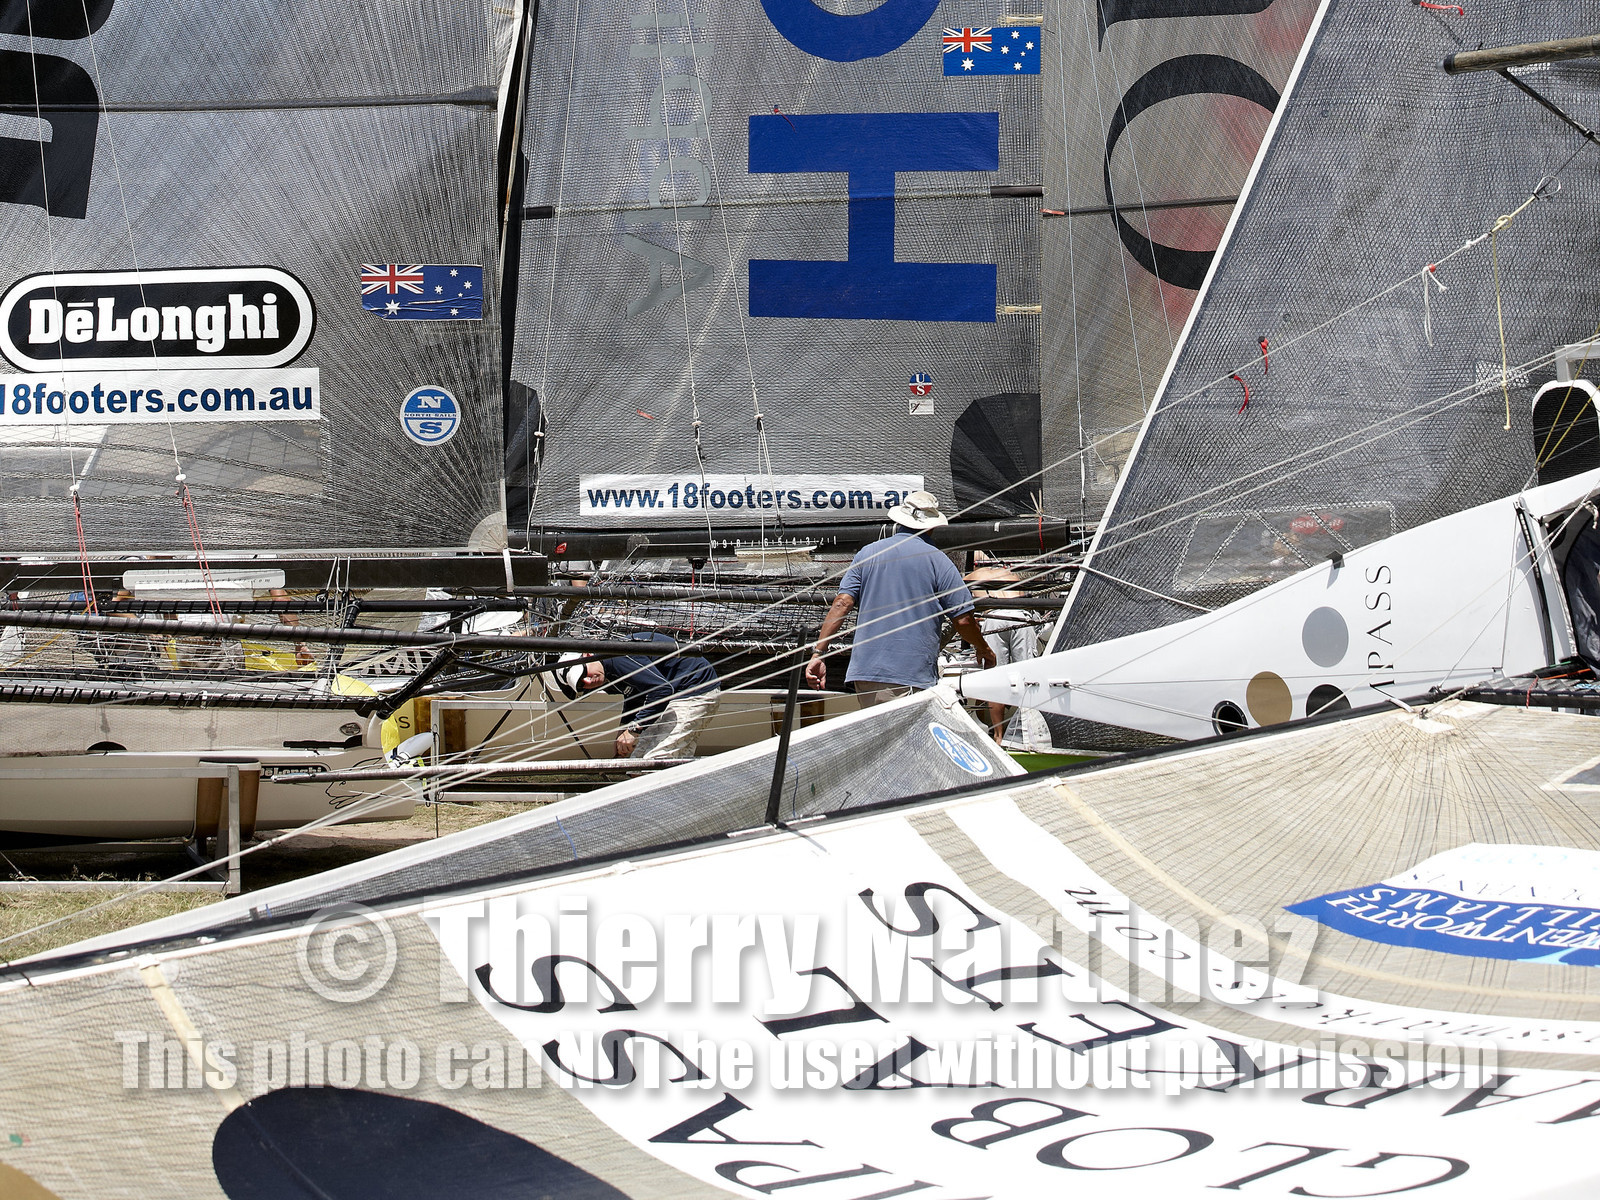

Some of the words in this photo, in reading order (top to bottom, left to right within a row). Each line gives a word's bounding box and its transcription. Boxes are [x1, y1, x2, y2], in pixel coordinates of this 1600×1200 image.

[587, 482, 918, 510] www.18footers.com.a
[1325, 894, 1600, 950] WENTWORTH
[1363, 886, 1600, 931] ILLIAMS
[859, 881, 1600, 1125] ARKETS
[475, 955, 965, 1200] PASS
[752, 966, 1469, 1198] GLOBAL
